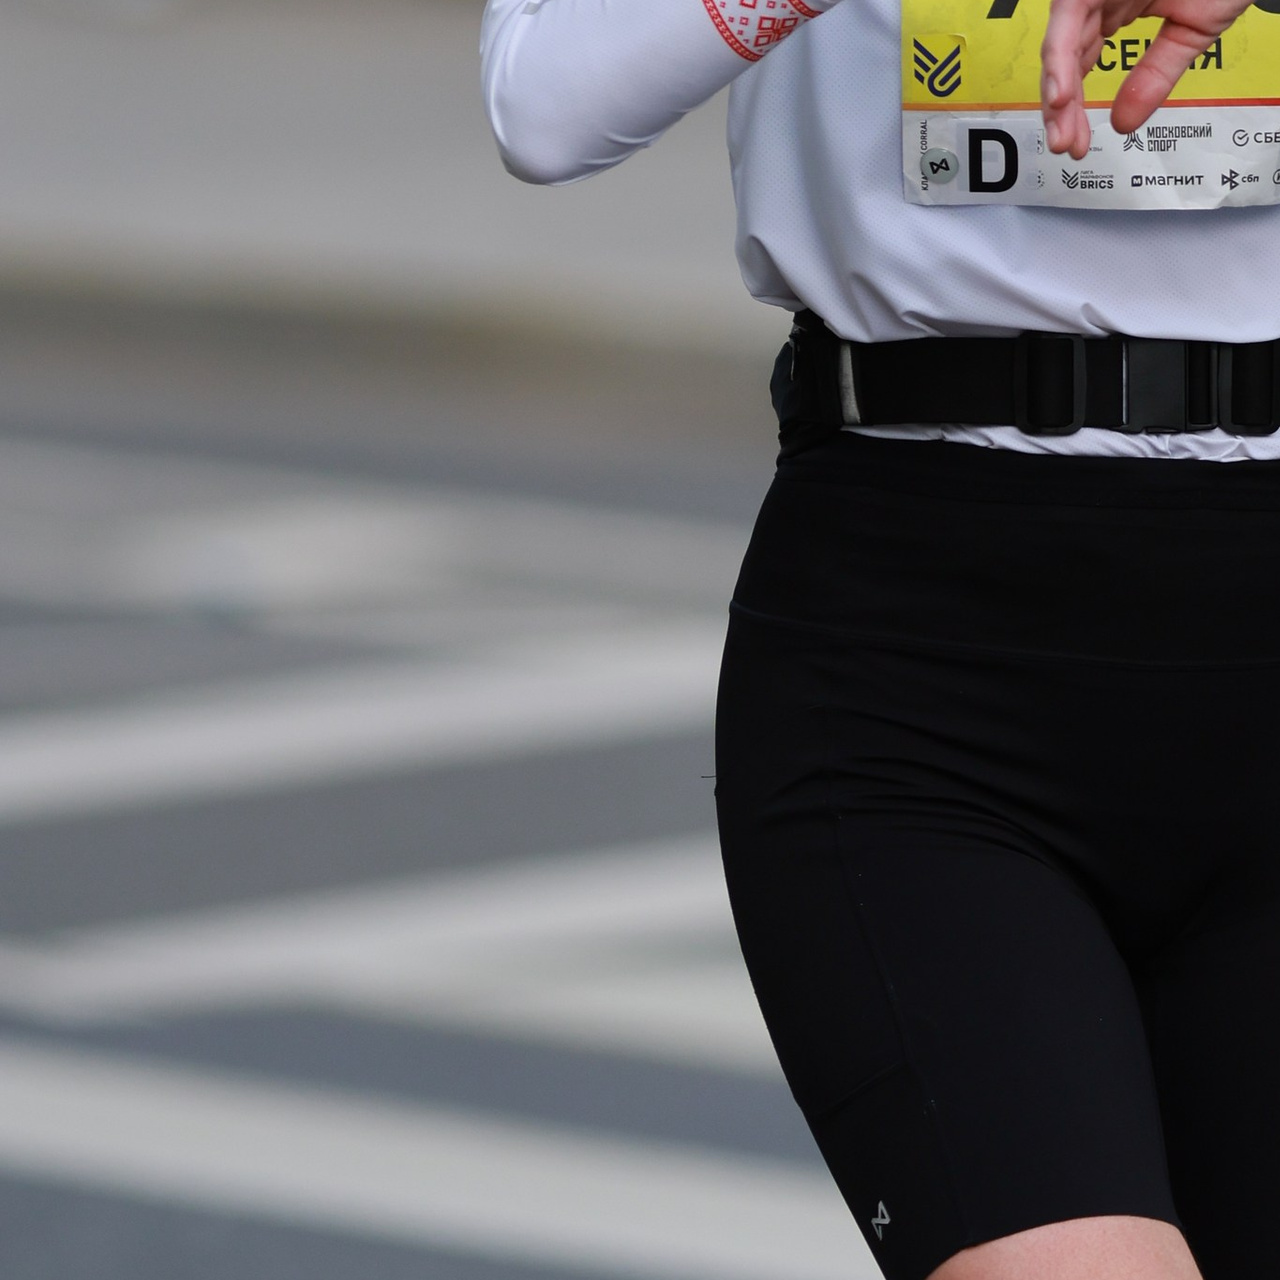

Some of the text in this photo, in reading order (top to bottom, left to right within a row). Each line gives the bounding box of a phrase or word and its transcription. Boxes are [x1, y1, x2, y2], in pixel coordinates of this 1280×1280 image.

[920, 119, 928, 151] CORRAL
[1146, 122, 1213, 139] МОСКОВСКИЙ
[1147, 139, 1178, 152] СПОРТ
[968, 128, 1019, 193] D
[1080, 180, 1114, 190] BRICS
